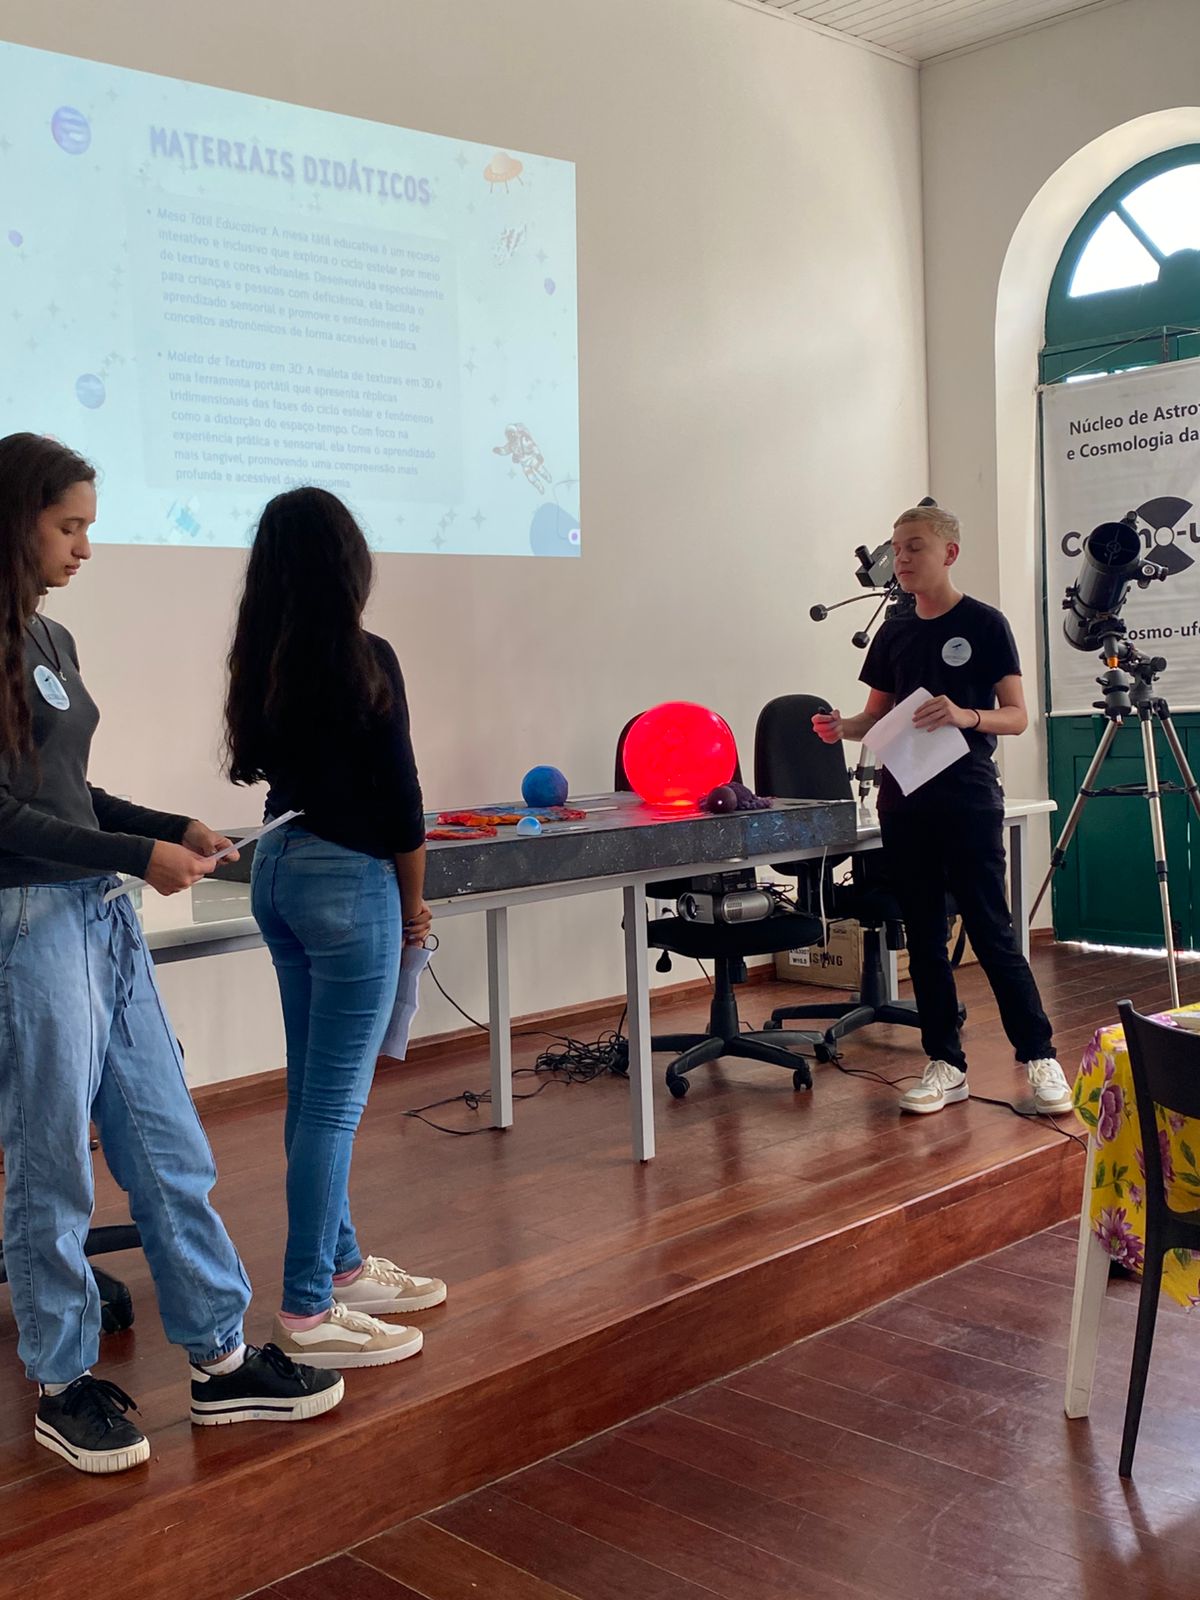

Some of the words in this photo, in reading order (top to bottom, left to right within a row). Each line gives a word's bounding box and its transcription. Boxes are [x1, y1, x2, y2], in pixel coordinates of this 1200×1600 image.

[302, 155, 431, 205] DIDÁTICOS
[1069, 415, 1124, 435] Núcleo
[1128, 410, 1148, 425] de
[1067, 449, 1075, 460] e
[1079, 431, 1173, 458] Cosmologia
[1179, 427, 1199, 442] da
